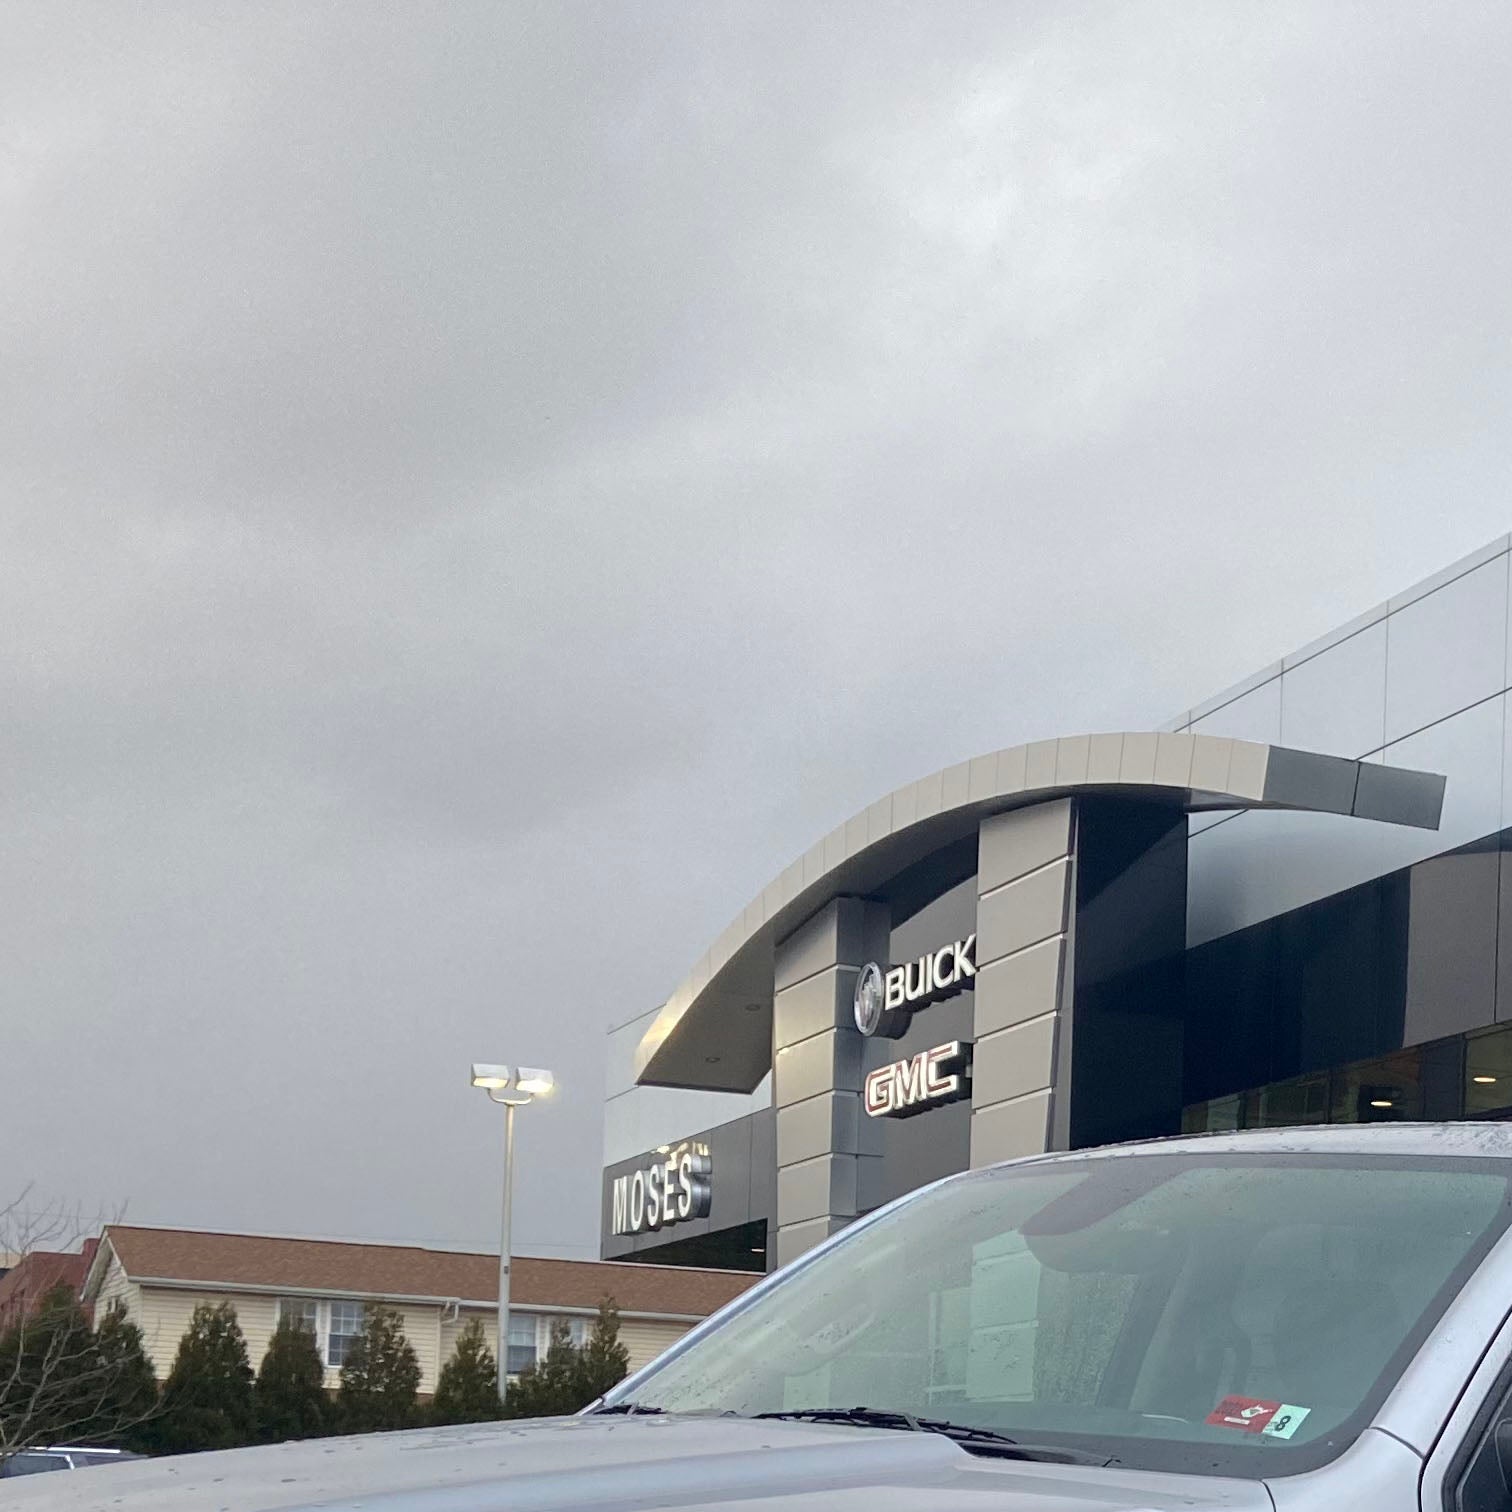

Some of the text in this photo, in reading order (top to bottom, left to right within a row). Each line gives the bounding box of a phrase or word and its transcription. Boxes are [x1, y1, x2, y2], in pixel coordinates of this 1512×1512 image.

[884, 934, 977, 1011] BUICK
[865, 1040, 959, 1117] GMC
[612, 1153, 692, 1235] MOSES
